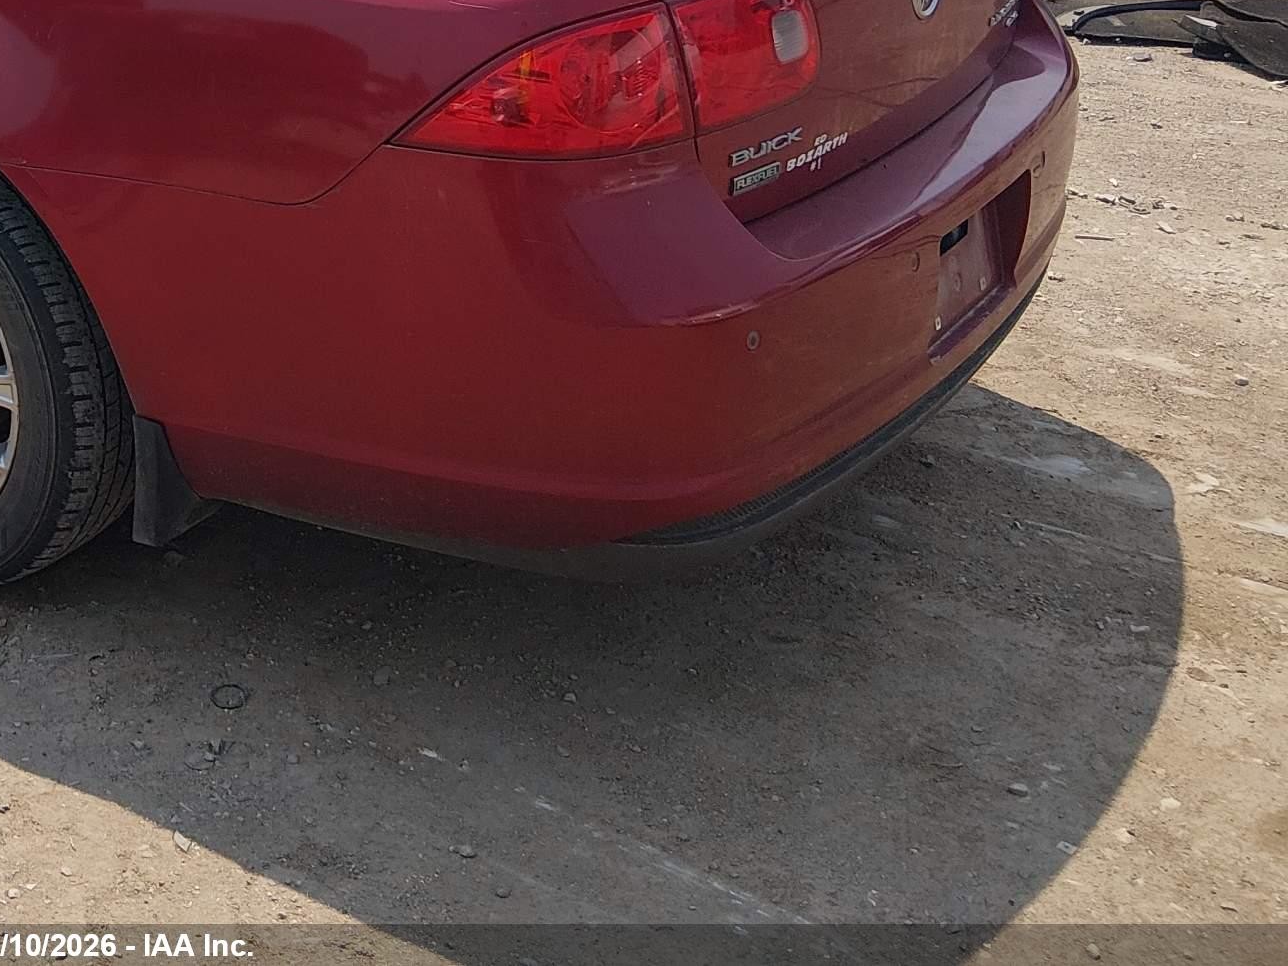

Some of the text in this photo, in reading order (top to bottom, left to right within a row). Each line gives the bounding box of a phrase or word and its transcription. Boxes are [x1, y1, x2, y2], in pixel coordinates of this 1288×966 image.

[730, 127, 803, 167] BUICK
[814, 134, 827, 146] ED
[735, 166, 778, 191] FLEXFUEL
